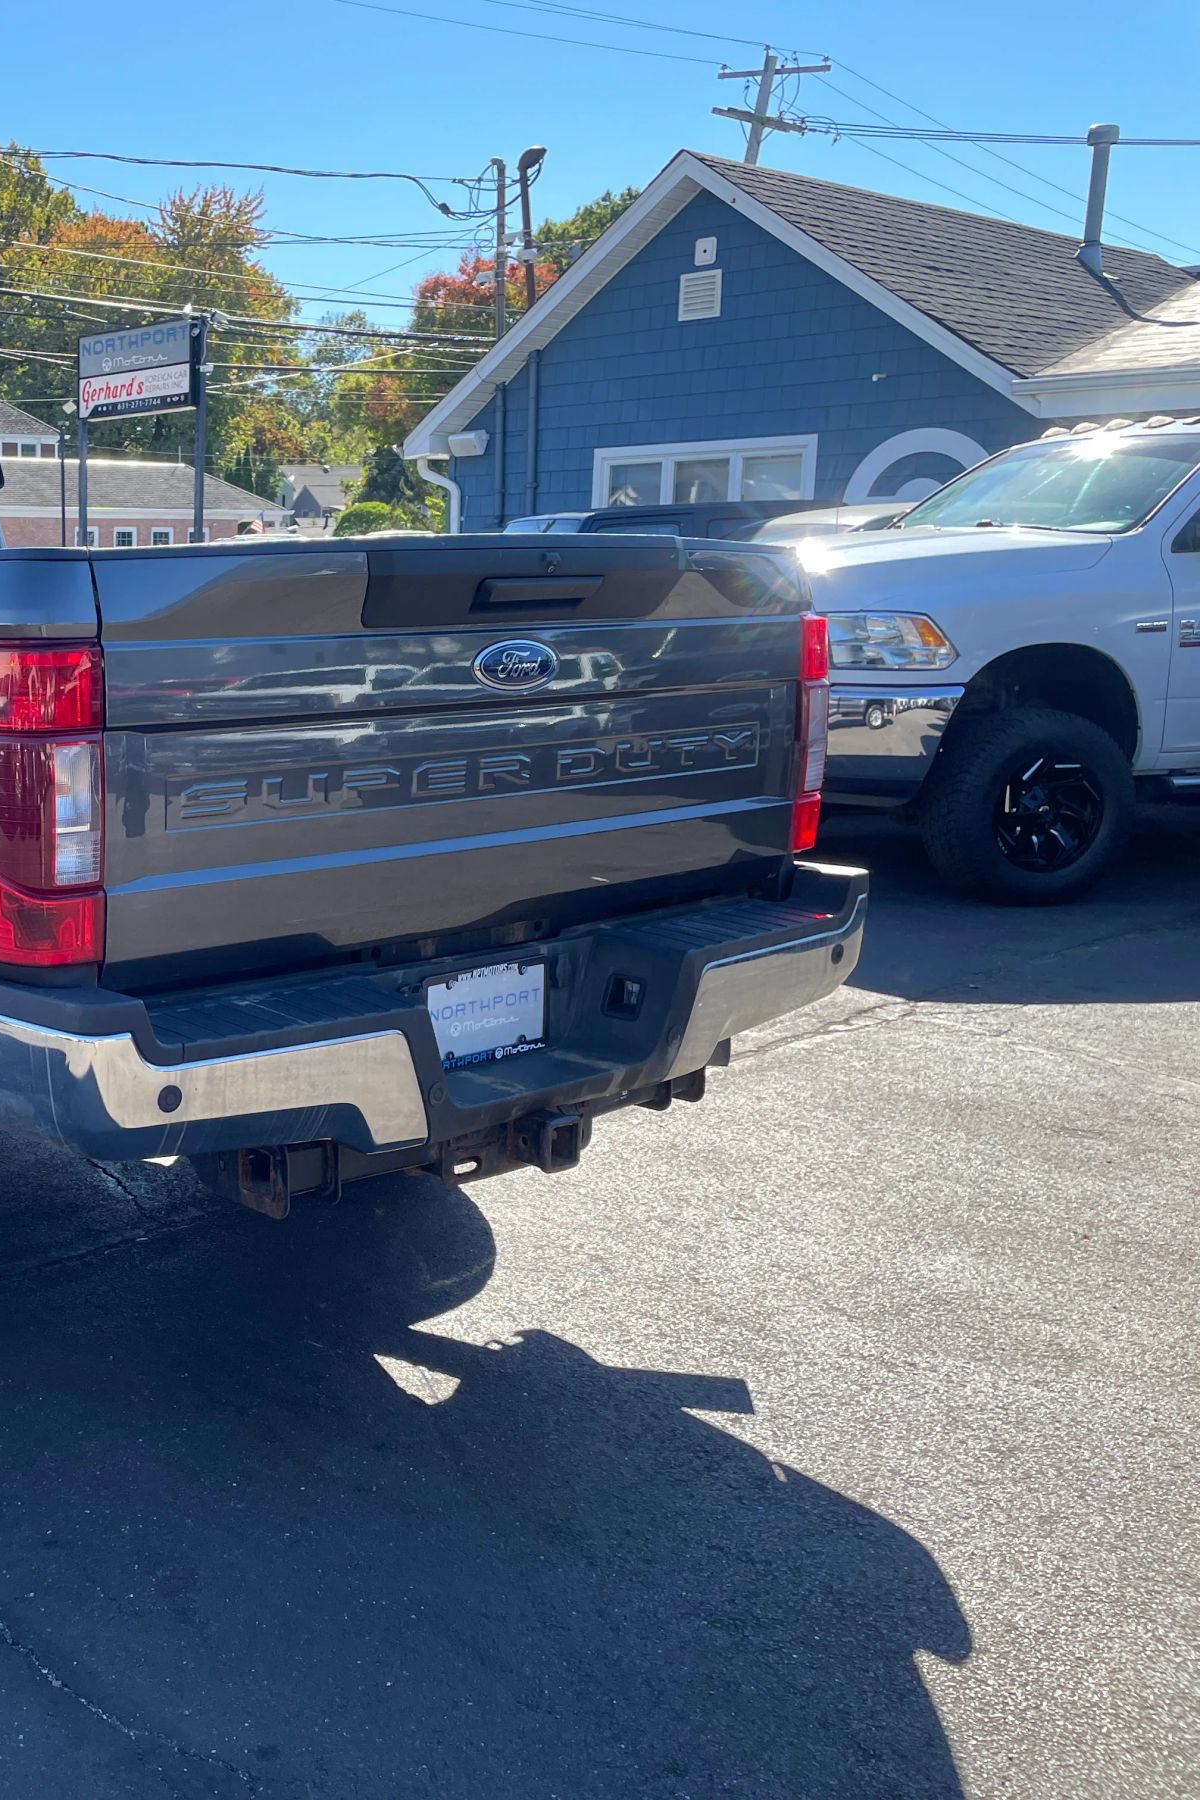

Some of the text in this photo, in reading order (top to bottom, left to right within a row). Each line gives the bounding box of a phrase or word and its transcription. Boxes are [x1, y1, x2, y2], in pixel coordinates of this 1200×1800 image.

[82, 325, 188, 357] NORTHPORT
[113, 353, 168, 367] Motors
[145, 372, 173, 384] FOREIGN
[82, 375, 144, 411] Gerhard's
[117, 398, 161, 411] 631-271-7744
[498, 650, 541, 678] Ford
[180, 730, 752, 819] SUPER DUTY
[430, 987, 541, 1022] NORTHPORT
[463, 1016, 520, 1032] Motors
[443, 1042, 546, 1070] RTHPORT Motors
